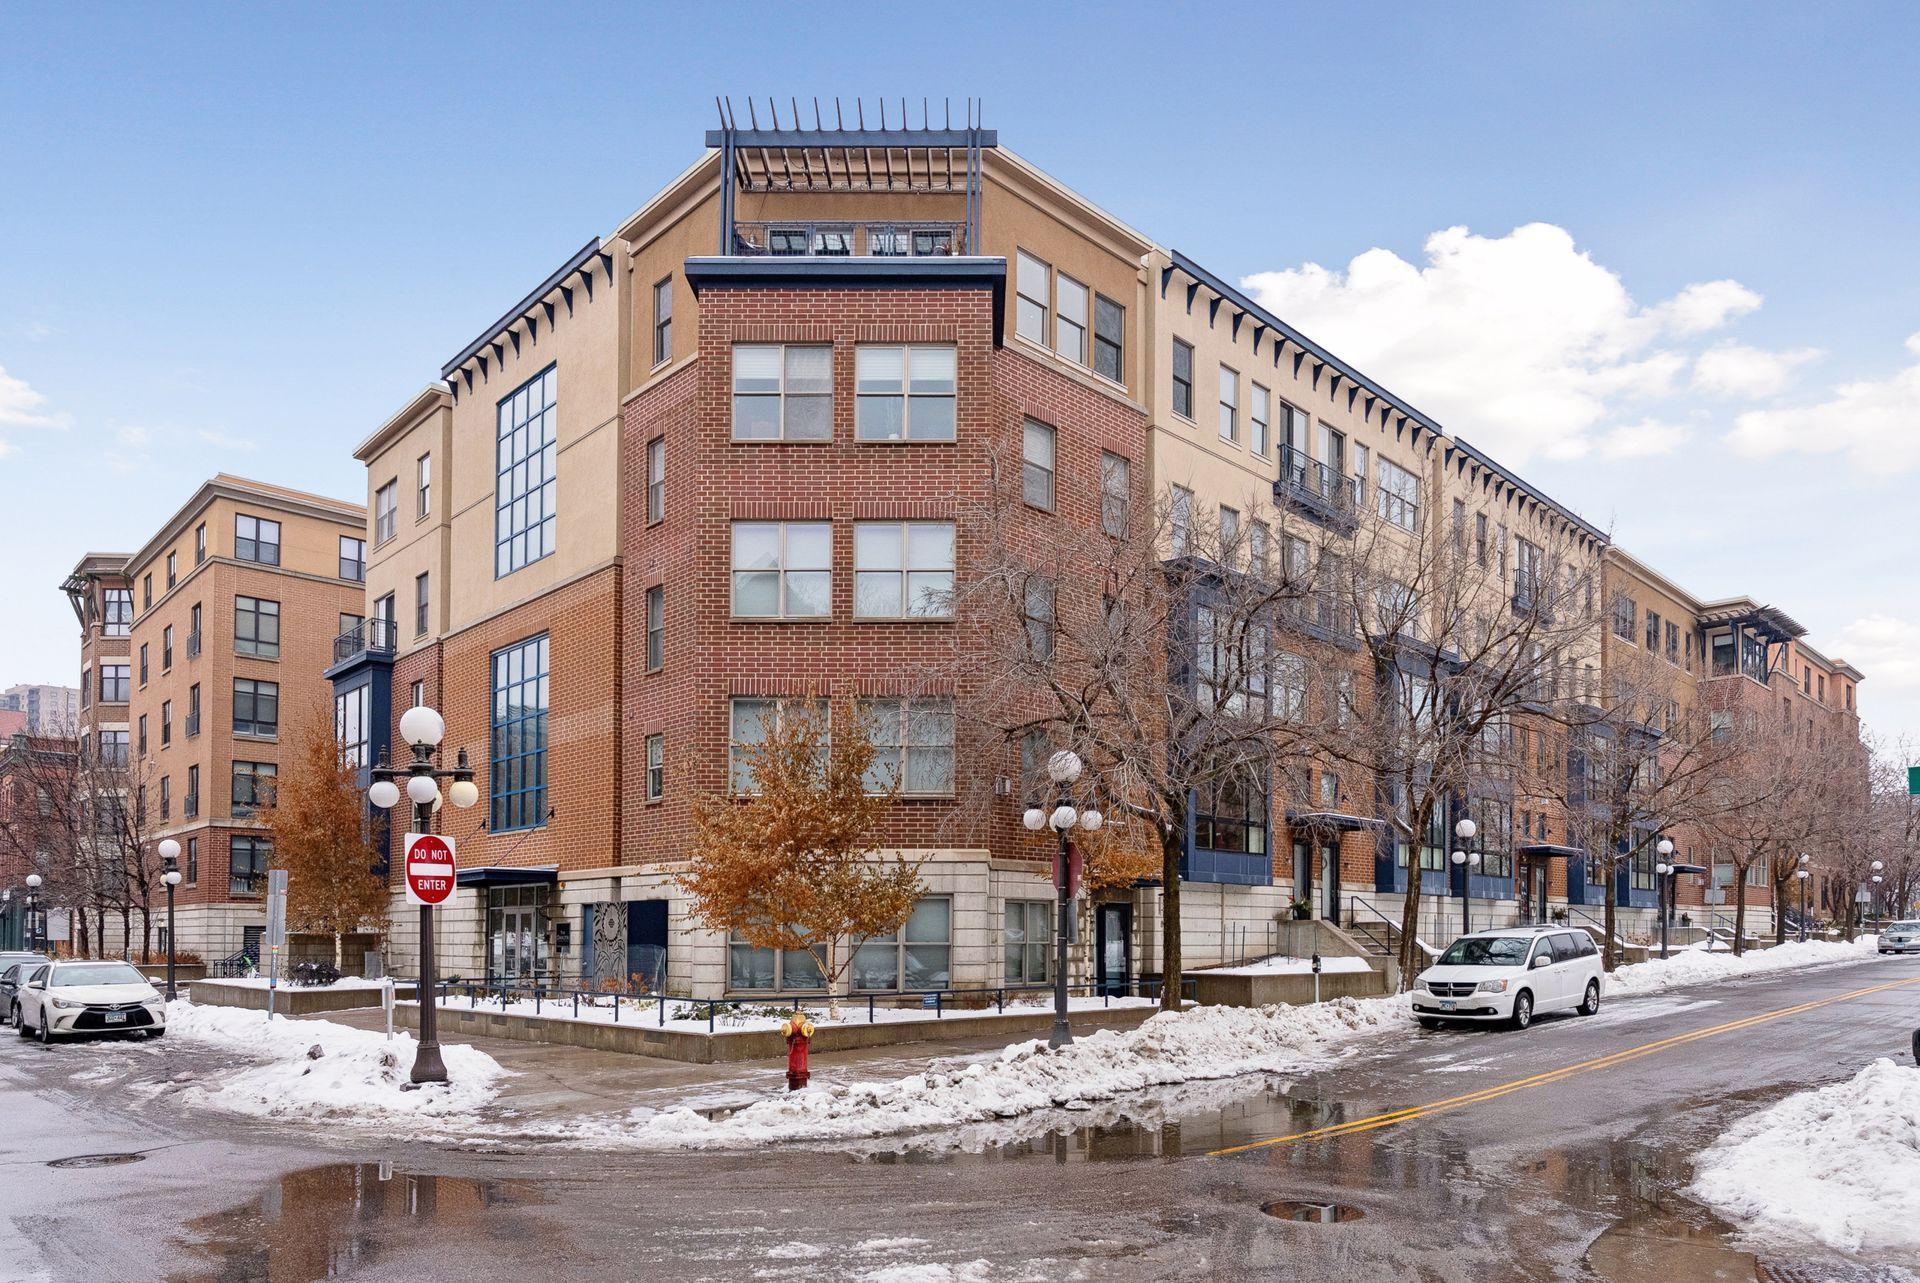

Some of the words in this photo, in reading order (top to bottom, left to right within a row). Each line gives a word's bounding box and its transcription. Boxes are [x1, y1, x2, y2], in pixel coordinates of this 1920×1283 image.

[414, 849, 426, 860] DO
[431, 850, 448, 861] NOT
[418, 879, 447, 891] ENTER
